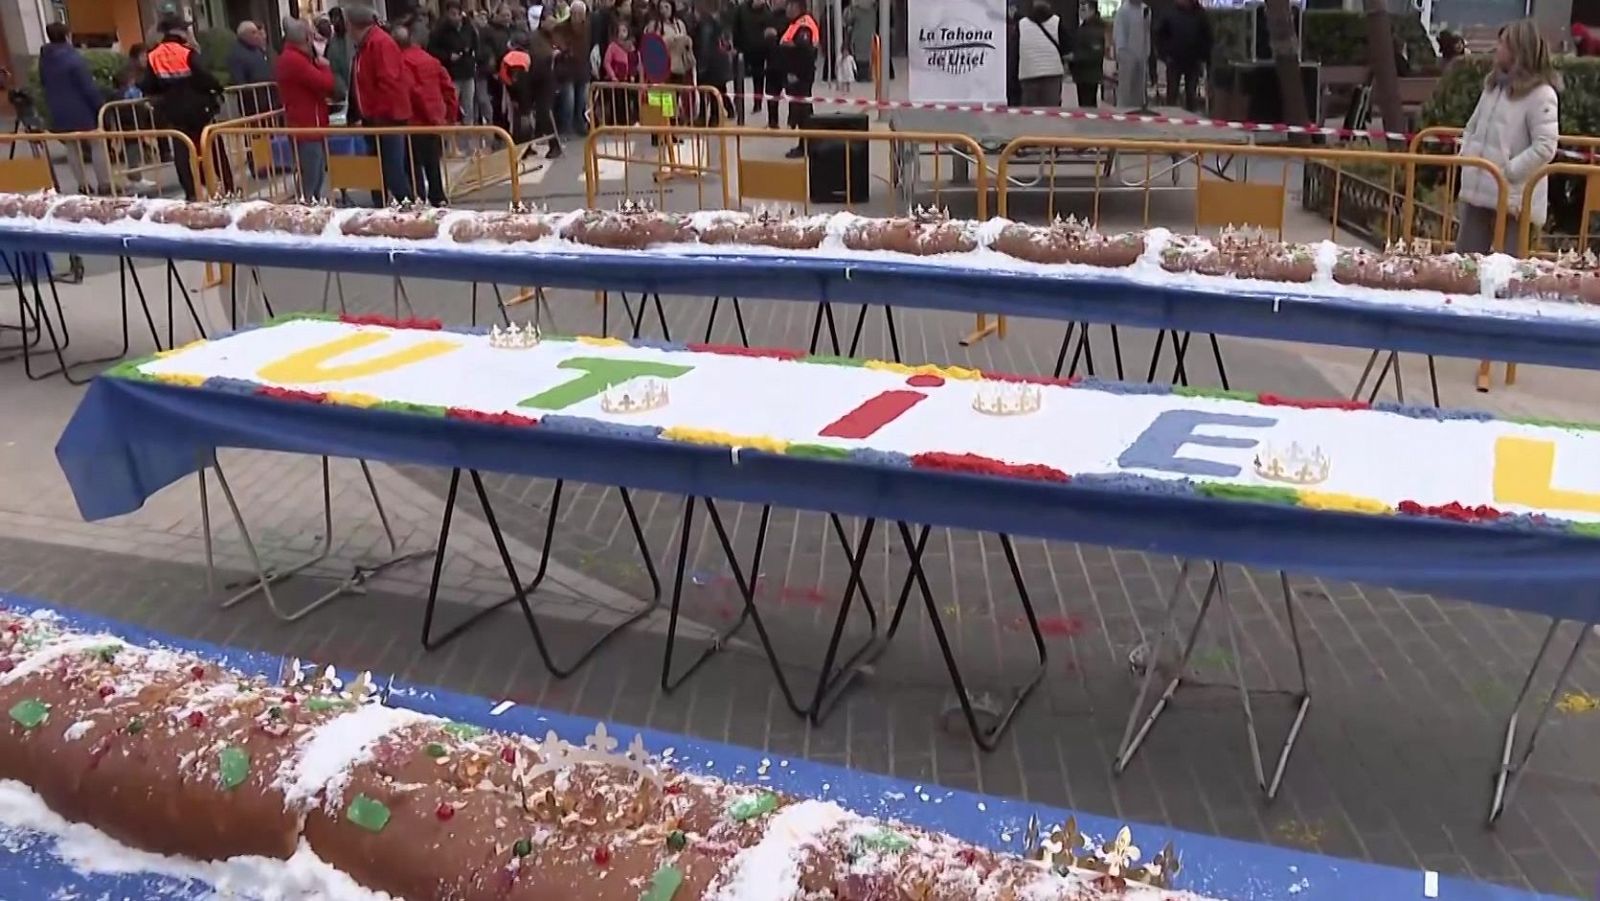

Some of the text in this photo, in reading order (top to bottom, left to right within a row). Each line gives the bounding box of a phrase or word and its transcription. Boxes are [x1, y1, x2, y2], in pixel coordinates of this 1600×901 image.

[919, 27, 993, 42] La Tahona
[928, 51, 985, 66] de Utiel
